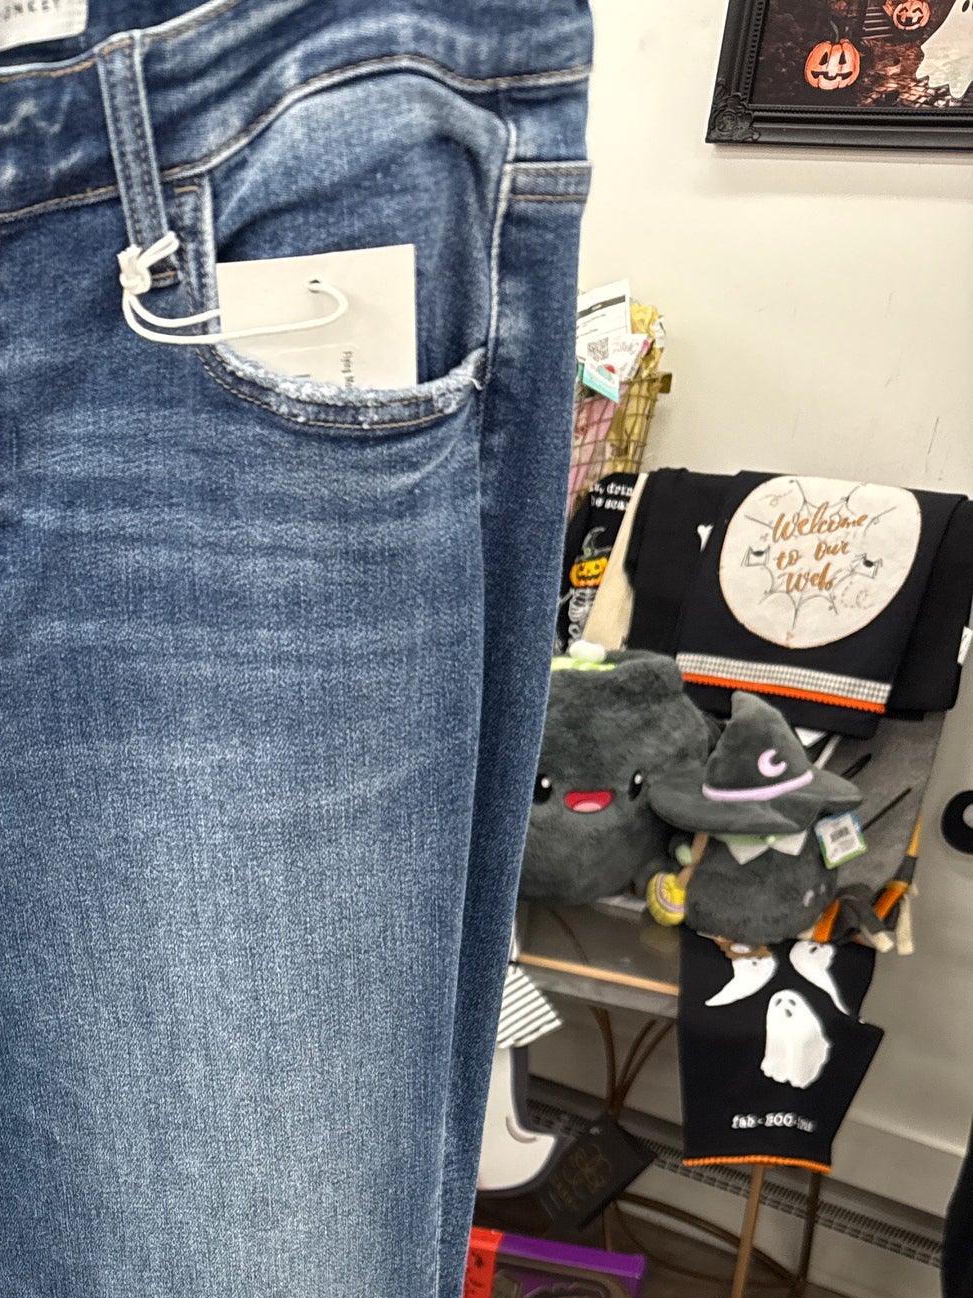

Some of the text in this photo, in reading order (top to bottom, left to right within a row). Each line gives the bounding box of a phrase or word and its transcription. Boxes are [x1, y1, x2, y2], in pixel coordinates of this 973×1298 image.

[772, 501, 868, 543] Welcome
[776, 540, 849, 570] to our
